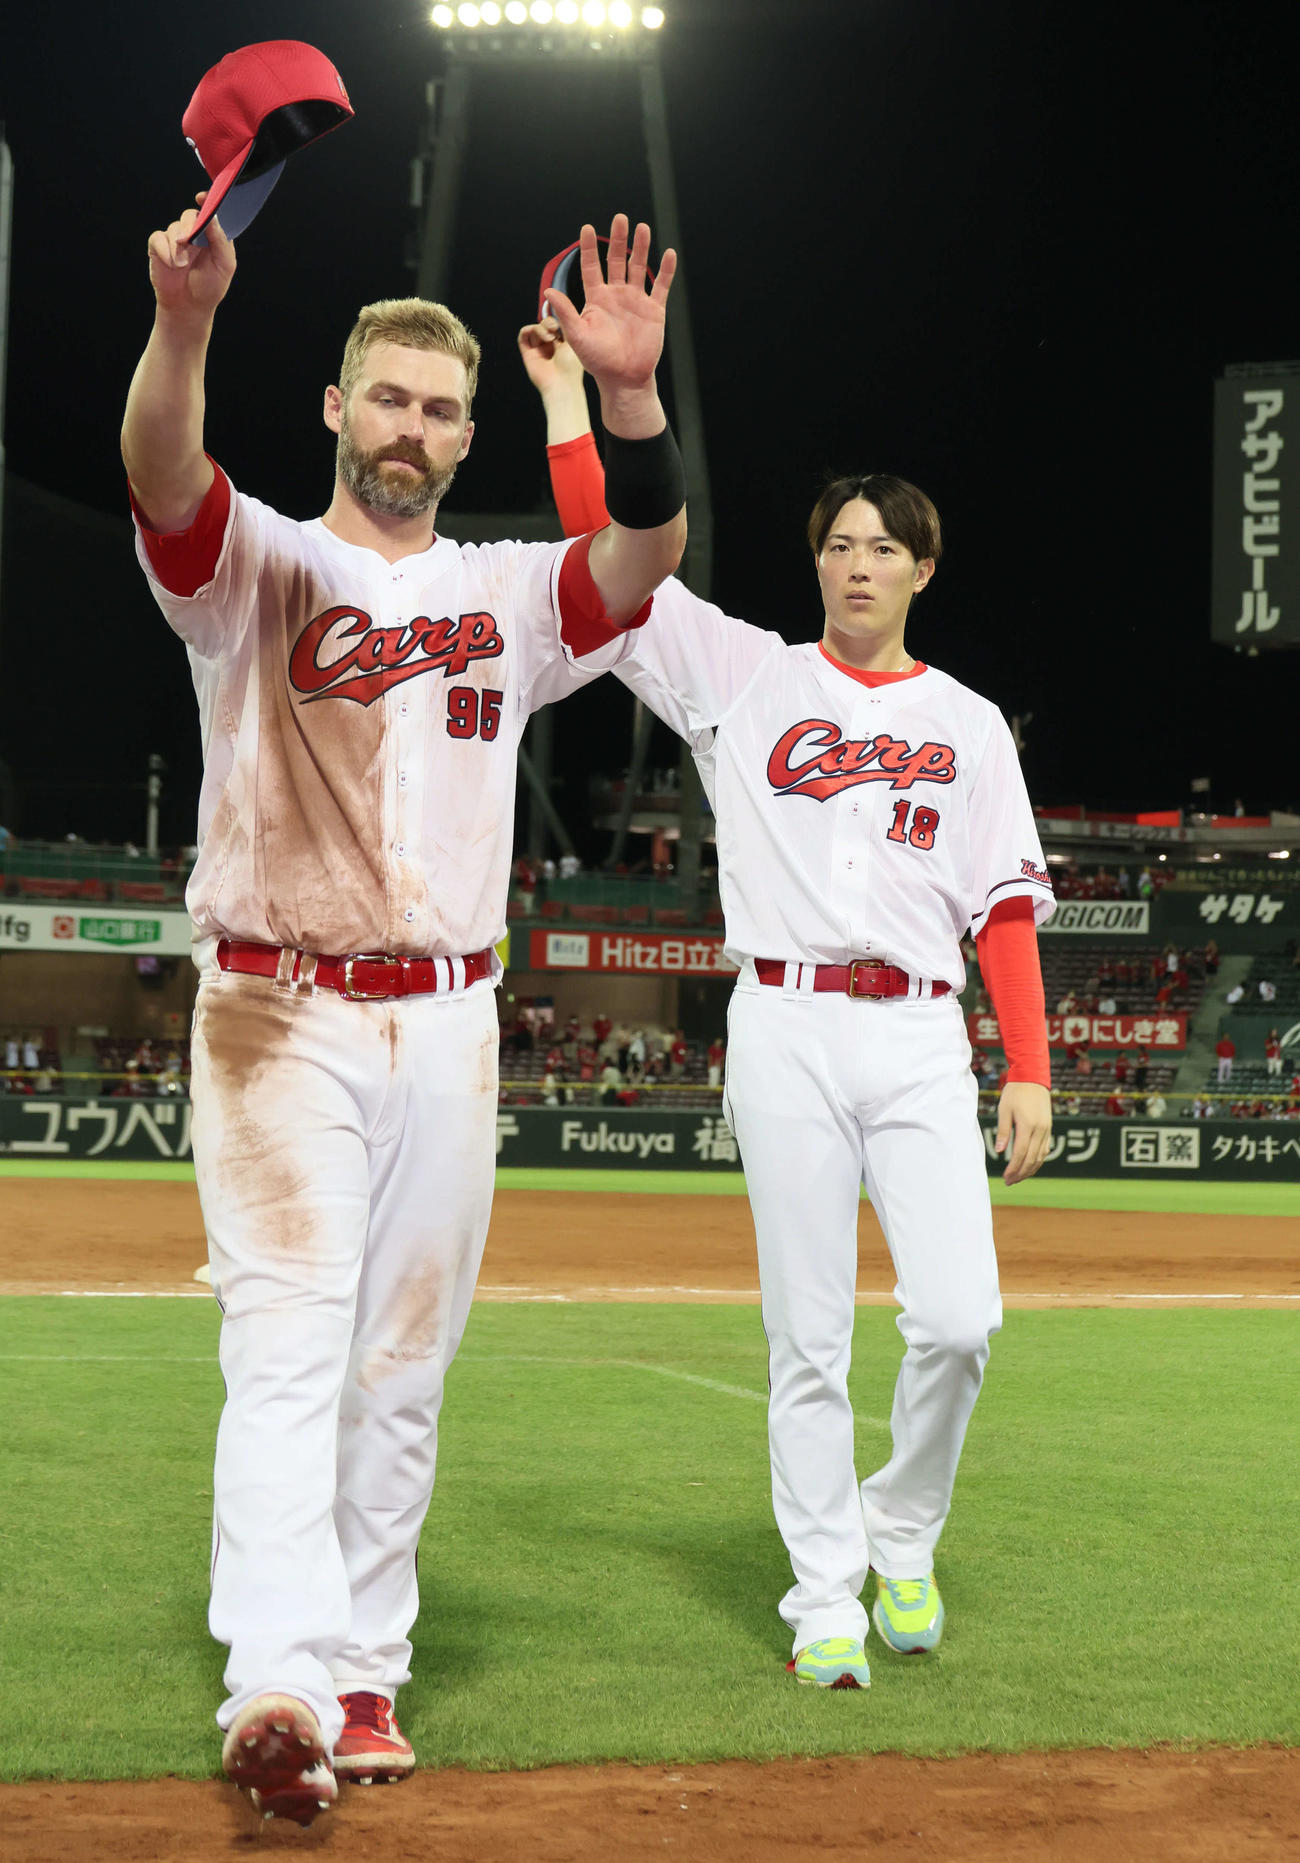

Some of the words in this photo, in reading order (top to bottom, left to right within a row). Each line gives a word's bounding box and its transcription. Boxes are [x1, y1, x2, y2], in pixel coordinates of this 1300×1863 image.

[1235, 389, 1283, 632] アサヒビール
[289, 605, 504, 707] Carp
[446, 686, 504, 742] 95
[767, 718, 957, 803] Carp
[886, 798, 940, 851] 18
[0, 914, 31, 942] fg
[1200, 894, 1284, 924] サタケ
[1092, 1018, 1180, 1045] にしき堂
[561, 1121, 675, 1158] Fukuya
